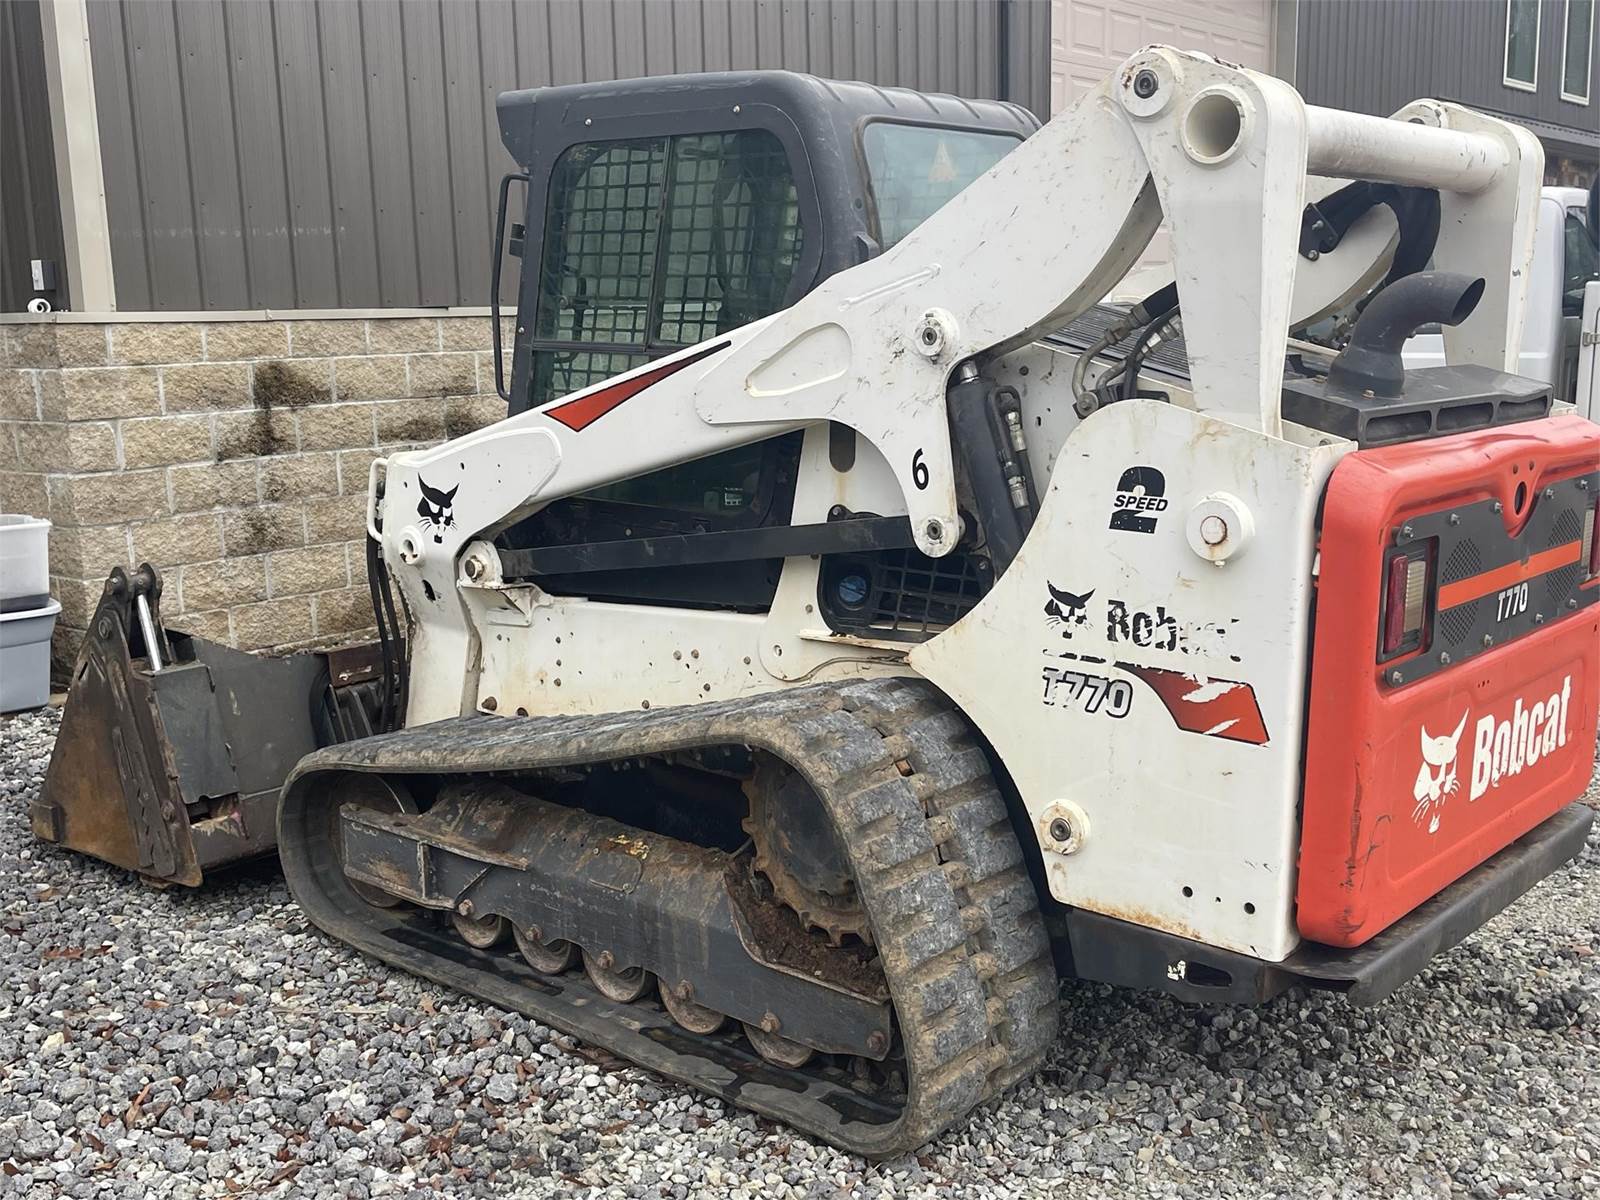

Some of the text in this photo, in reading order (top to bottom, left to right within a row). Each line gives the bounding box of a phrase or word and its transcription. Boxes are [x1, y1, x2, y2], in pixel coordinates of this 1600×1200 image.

[912, 447, 929, 490] 6
[1109, 466, 1165, 534] 2
[1113, 494, 1168, 511] SPEED
[1496, 582, 1528, 622] T770
[1107, 599, 1241, 662] Bob
[1042, 666, 1133, 718] T770
[1469, 675, 1571, 801] Bobcat
